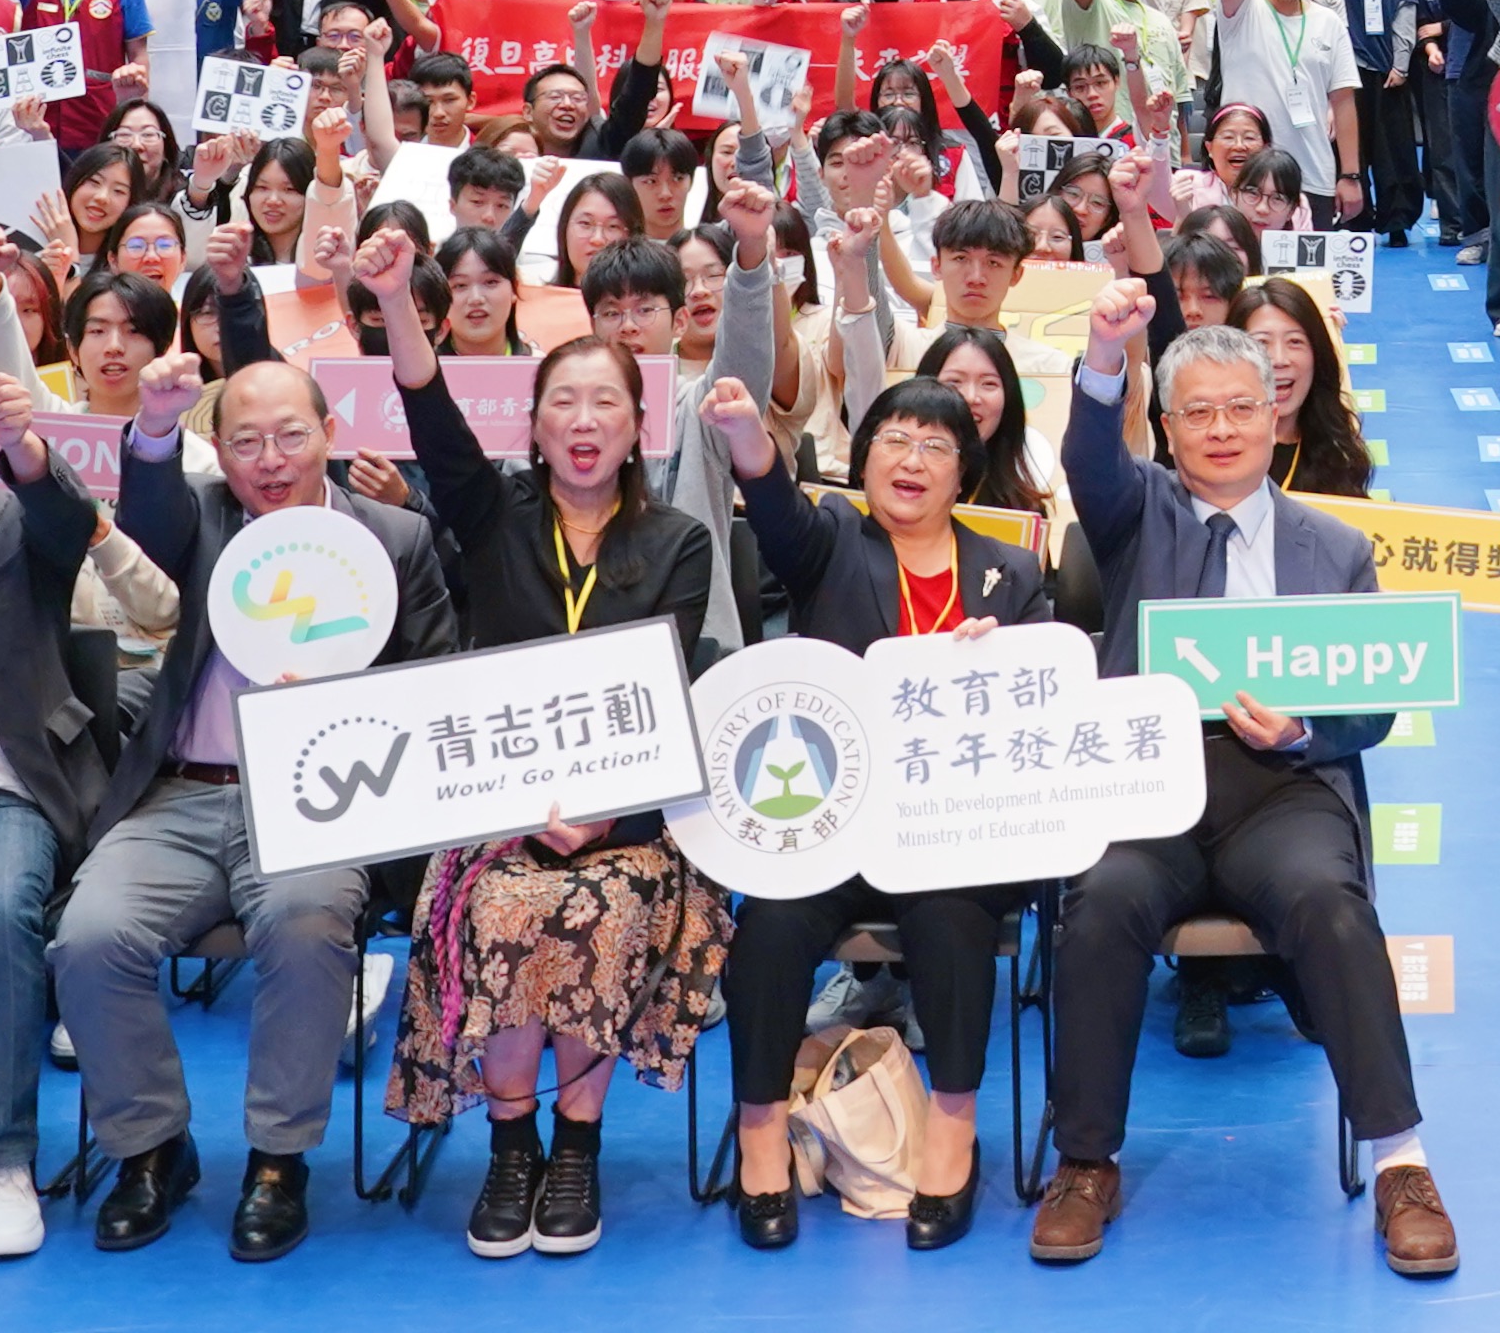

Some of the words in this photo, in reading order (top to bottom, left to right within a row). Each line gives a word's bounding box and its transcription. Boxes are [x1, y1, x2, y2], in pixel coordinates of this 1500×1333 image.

[1245, 634, 1429, 686] Happy
[892, 666, 1058, 722] 教育部
[427, 680, 658, 772] 青志行動
[894, 712, 1168, 786] 青年發展署
[434, 773, 507, 803] Wow!
[522, 764, 555, 787] Go
[567, 743, 662, 778] Action!
[709, 713, 751, 822] MINISTRY
[757, 689, 787, 714] OF
[793, 690, 861, 811] EDUCATION
[894, 797, 940, 821] Youth
[944, 786, 1043, 818] Development
[1048, 776, 1166, 804] Administration
[738, 808, 841, 853] 教育部
[896, 825, 965, 851] Ministry
[967, 823, 985, 845] of
[988, 814, 1067, 839] Education
